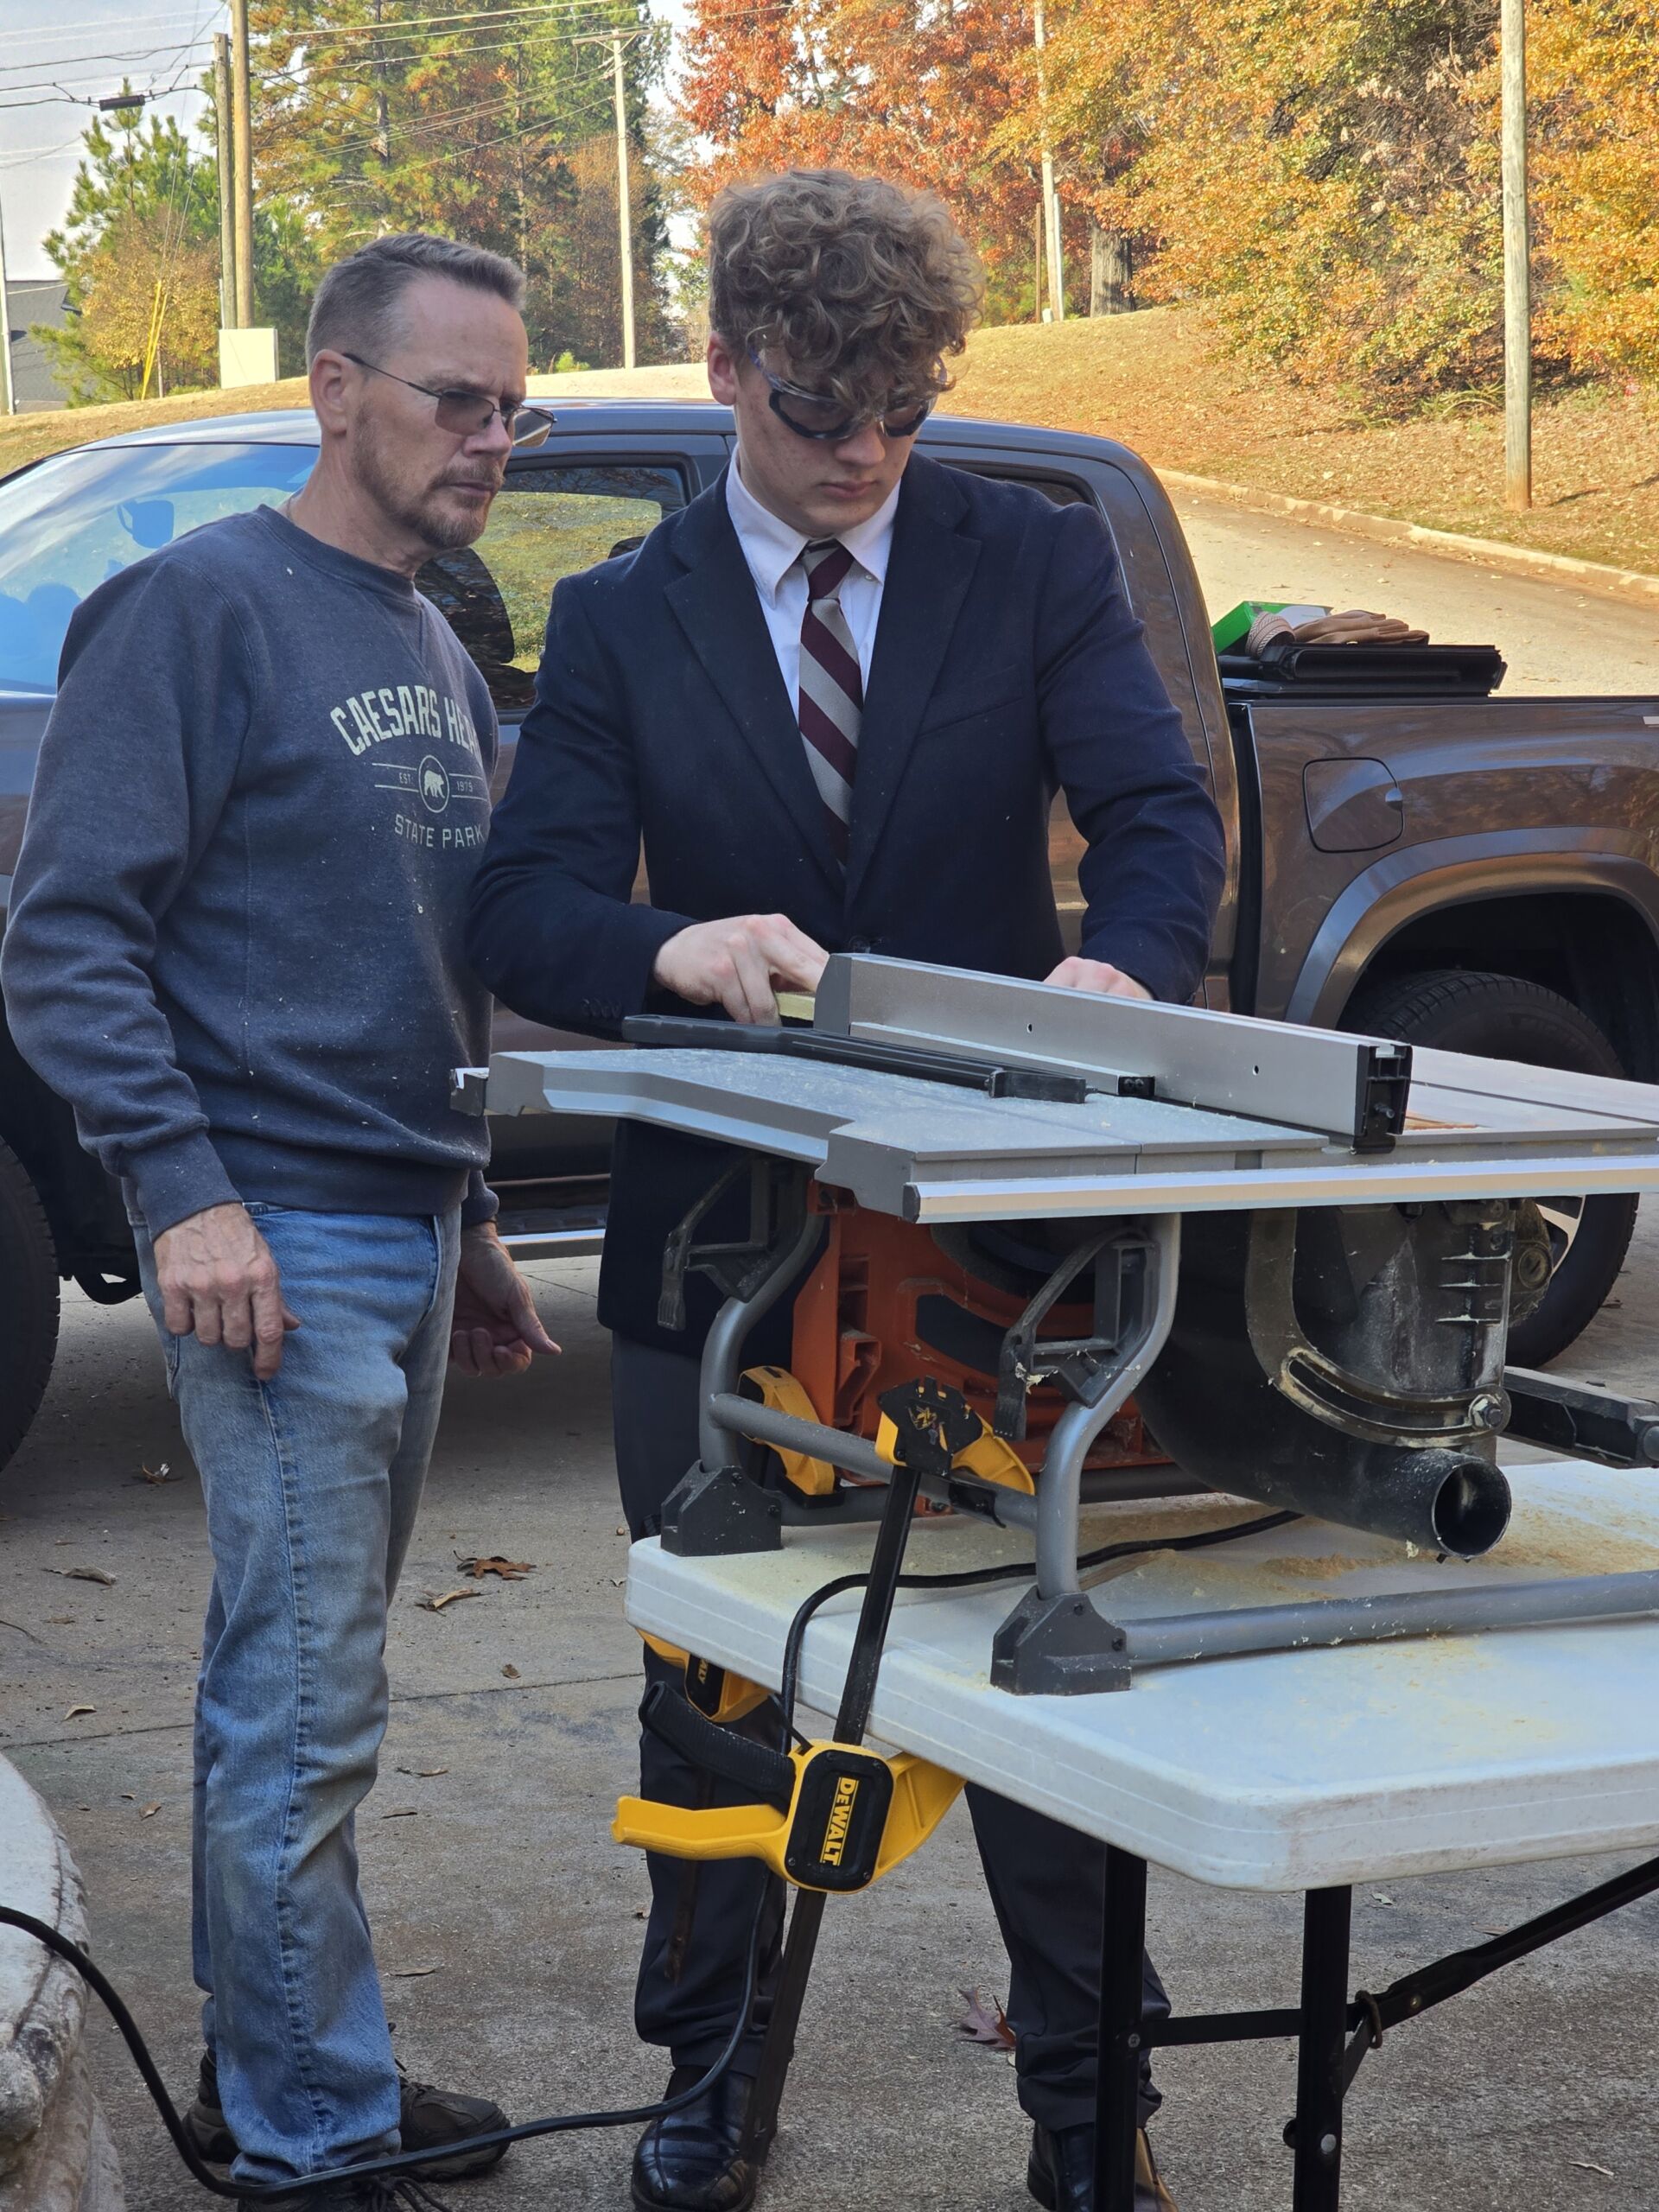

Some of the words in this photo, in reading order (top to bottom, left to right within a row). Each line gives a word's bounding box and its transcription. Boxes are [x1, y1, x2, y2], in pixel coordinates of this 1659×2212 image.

[330, 685, 442, 756] CAESARS
[394, 813, 435, 848] STATE
[442, 824, 486, 849] PARK
[823, 1777, 858, 1866] DEWALT
